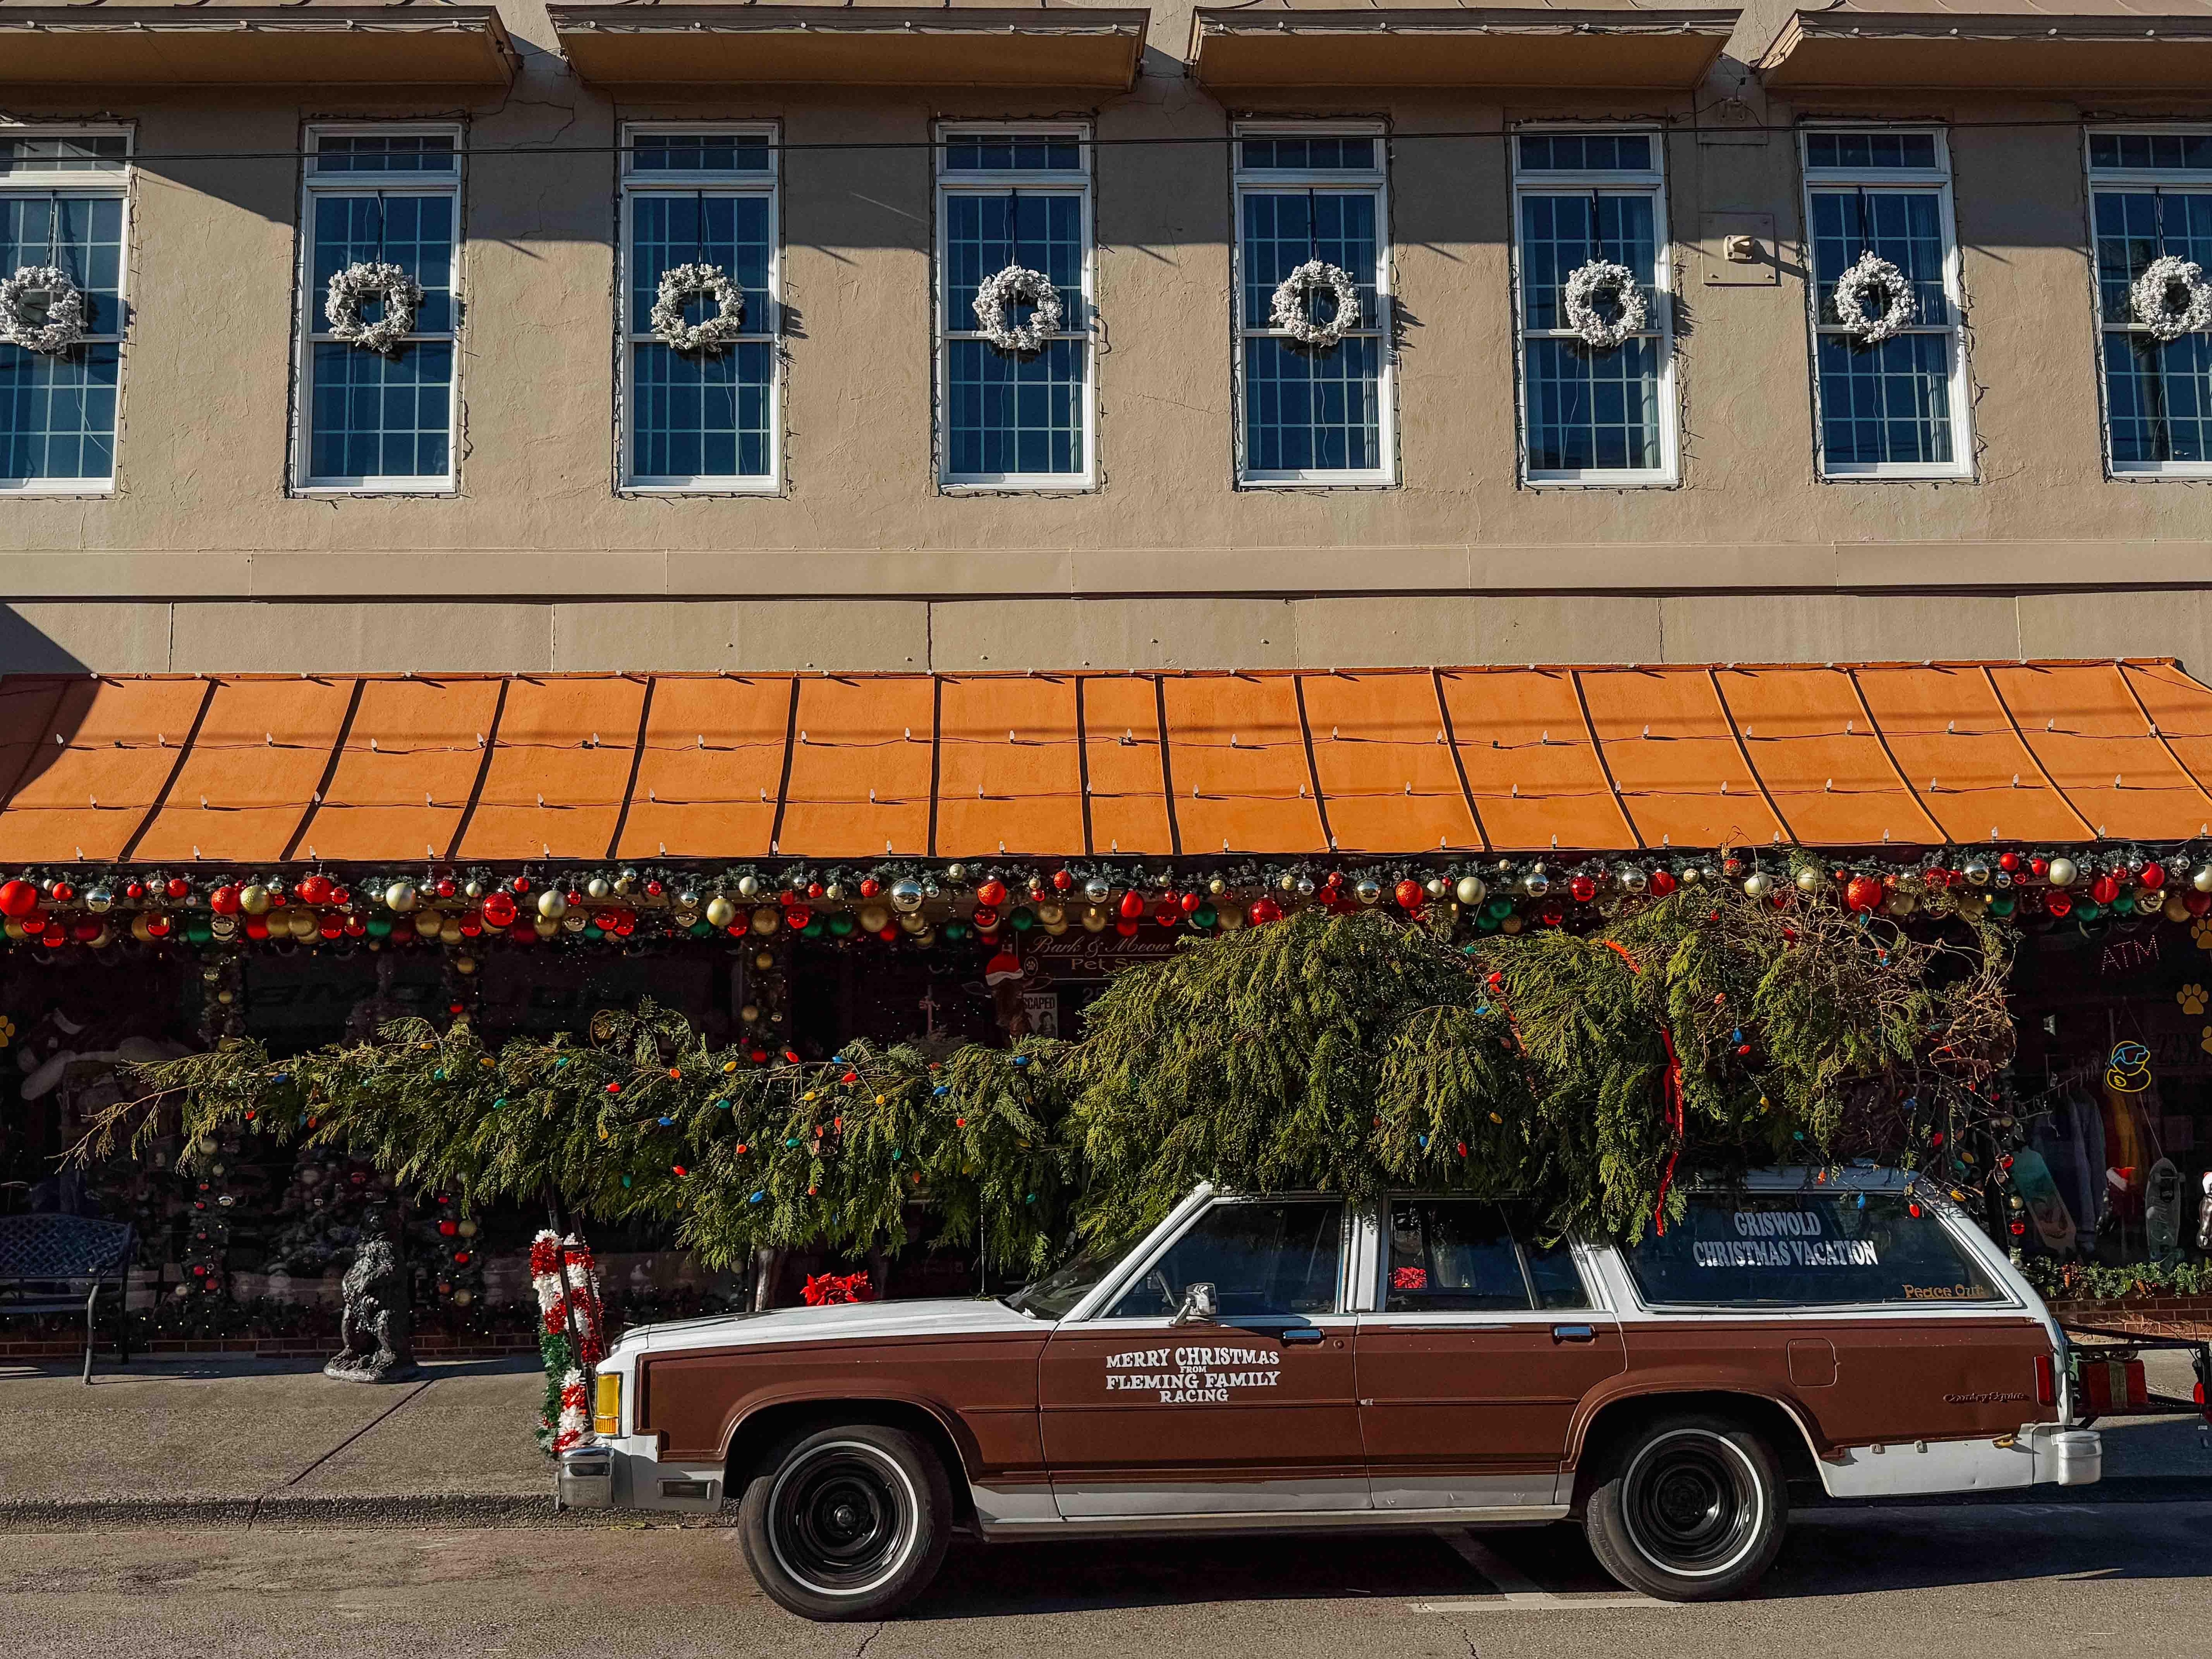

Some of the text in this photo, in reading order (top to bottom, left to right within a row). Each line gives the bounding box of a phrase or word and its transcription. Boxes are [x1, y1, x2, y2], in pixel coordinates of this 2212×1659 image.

[1027, 935, 1084, 953] Bark
[1085, 936, 1103, 958] &
[1105, 935, 1172, 952] Meow
[2101, 934, 2159, 974] ATM
[1071, 958, 1106, 970] Pet
[1023, 997, 1055, 1010] SCAPED
[1734, 1212, 1821, 1236] GRISWOLD
[1693, 1240, 1878, 1267] CHRISTMAS VACATION
[1902, 1284, 1952, 1298] Peace
[1106, 1347, 1279, 1368] MERRY CHRISTMAS
[1106, 1371, 1281, 1390] FLEMING FAMILY
[1160, 1388, 1229, 1403] RACING
